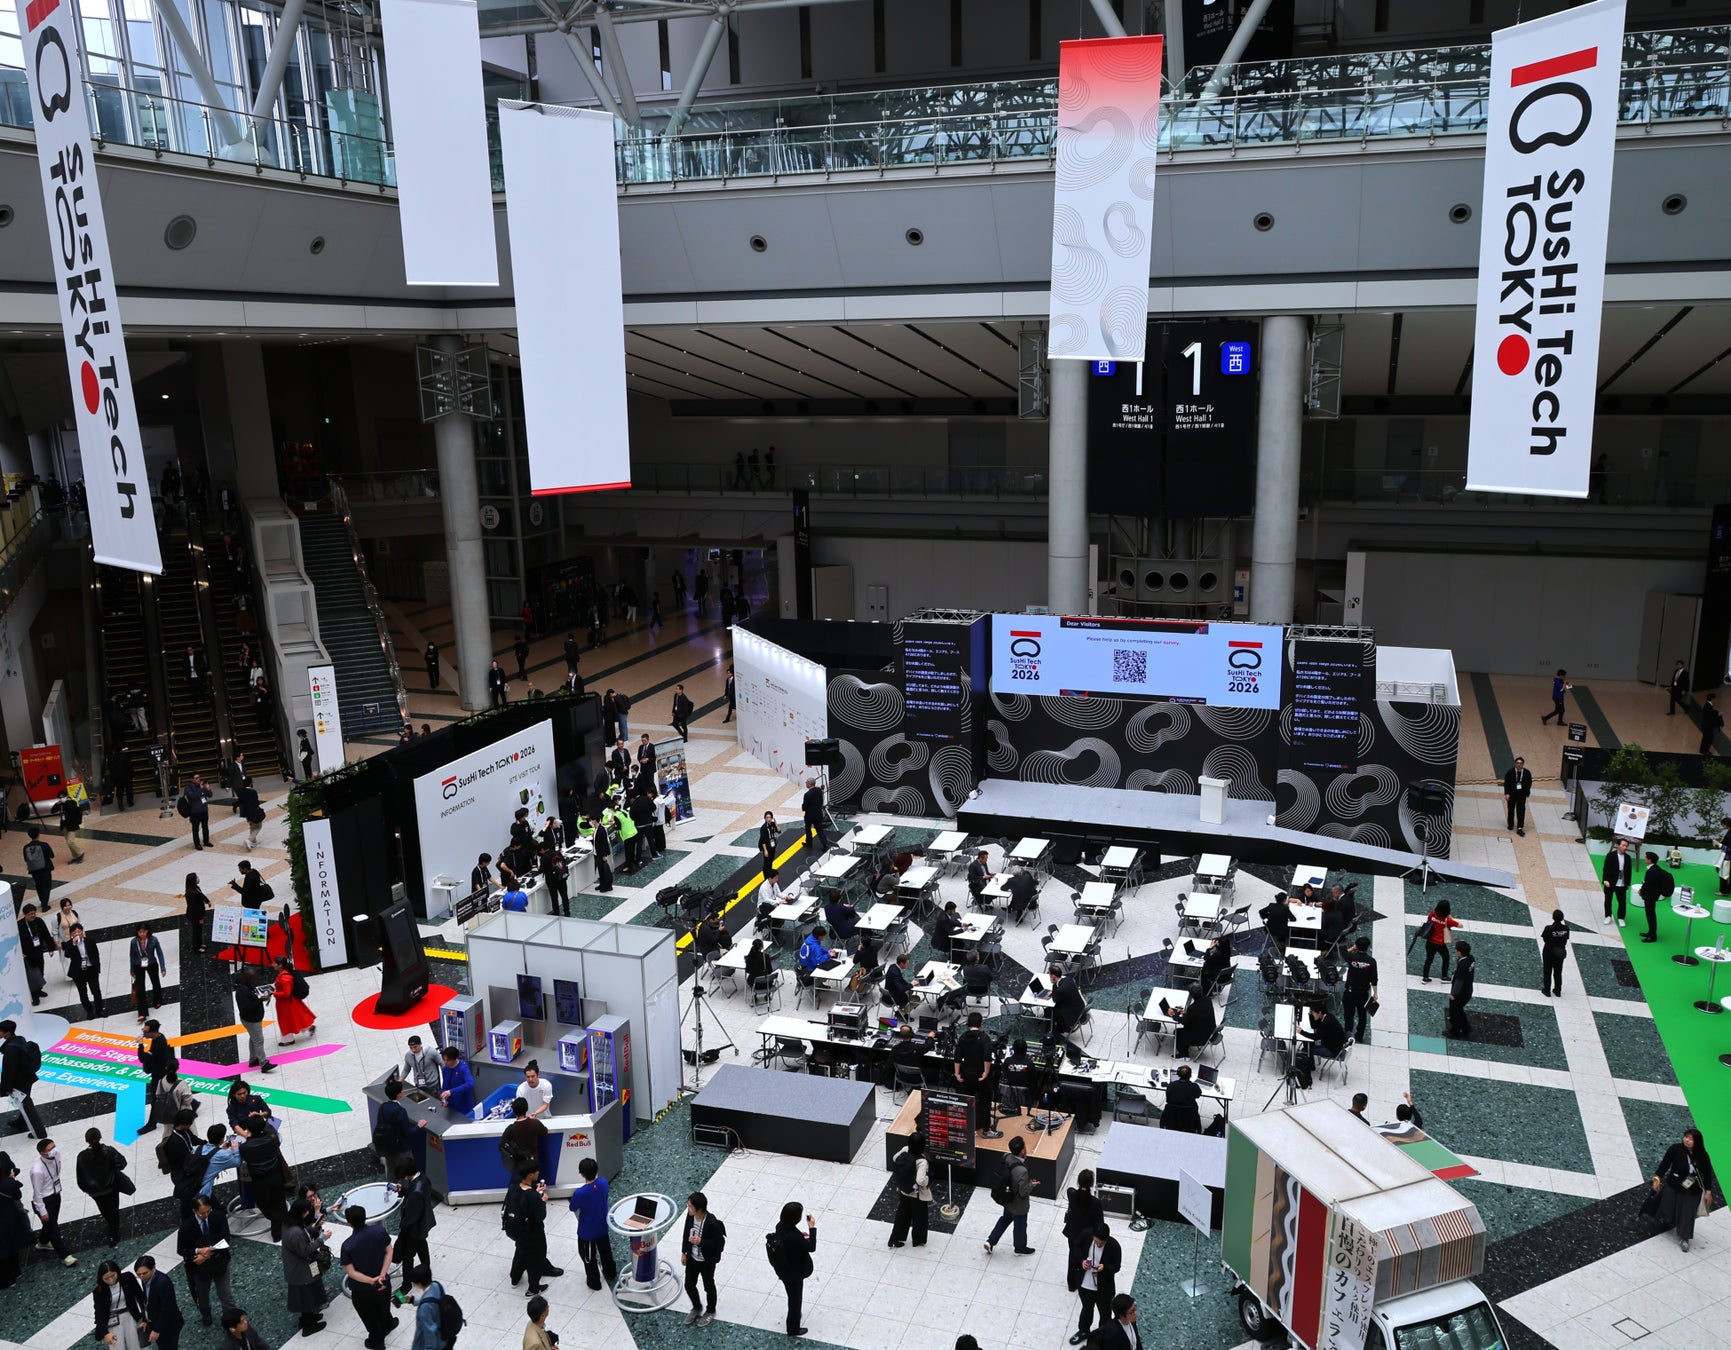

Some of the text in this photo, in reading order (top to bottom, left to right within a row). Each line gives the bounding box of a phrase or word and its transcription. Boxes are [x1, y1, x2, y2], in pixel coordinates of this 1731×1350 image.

[1530, 168, 1585, 457] SusHi Tech
[63, 142, 138, 519] SusHi Tech
[1181, 342, 1202, 395] 1
[1229, 354, 1243, 372] 西
[1122, 404, 1154, 413] 西1ホール
[1138, 414, 1149, 422] Hall
[1176, 404, 1214, 414] 西1ホール
[1176, 414, 1212, 423] West Hall 1
[1011, 670, 1040, 680] 2026
[1228, 682, 1259, 693] 2026
[458, 772, 478, 788] SusHi
[478, 764, 495, 778] Tech
[520, 745, 535, 759] 2026
[509, 764, 541, 784] SITE VISIT TOUR
[667, 781, 684, 789] Tokyo
[440, 796, 475, 819] INFORMATION
[317, 841, 336, 945] INFORMATION
[55, 1043, 140, 1063] Atrium Stage
[41, 1054, 117, 1073] Ambassador
[115, 1067, 130, 1075] &
[184, 1077, 218, 1090] Event
[56, 1072, 130, 1091] Experience
